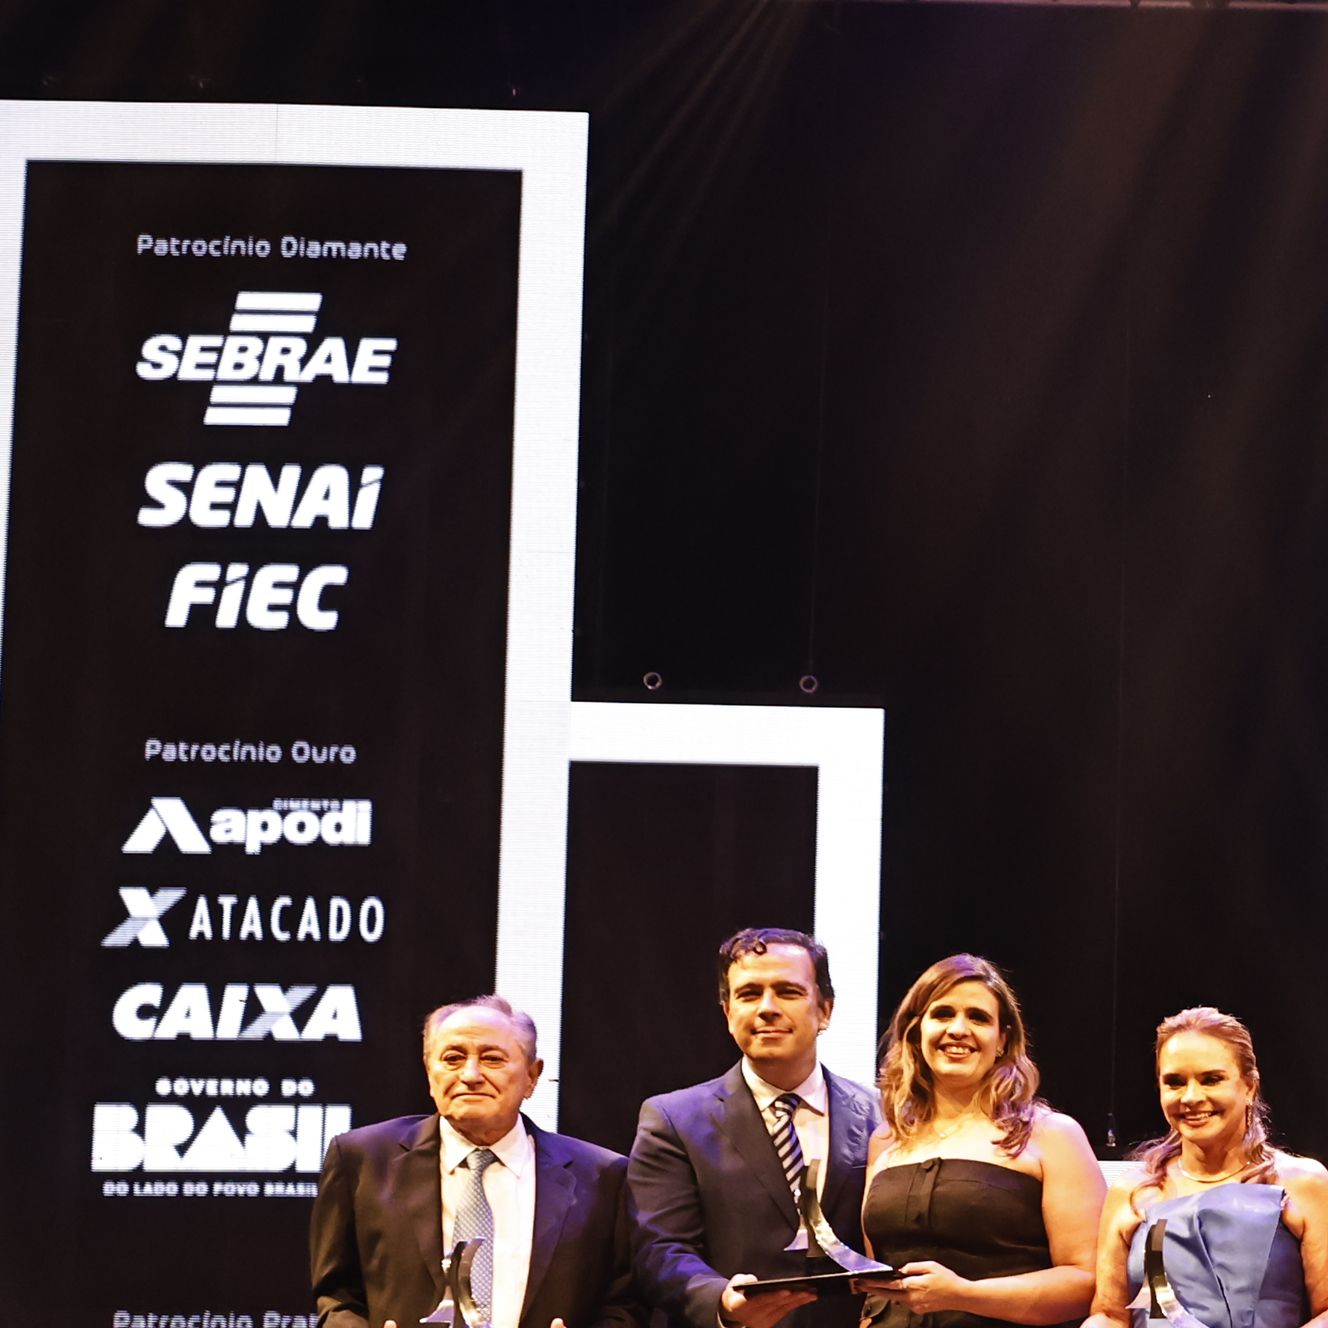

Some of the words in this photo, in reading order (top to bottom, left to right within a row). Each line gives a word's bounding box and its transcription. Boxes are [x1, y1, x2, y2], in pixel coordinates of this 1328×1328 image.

[137, 235, 271, 257] Patrocínio
[281, 236, 407, 260] Diamante
[136, 334, 398, 384] SEBRAE
[145, 738, 282, 763] Patrocínio
[291, 741, 356, 764] Ouro
[189, 894, 384, 942] ATACADO
[112, 982, 362, 1042] CAIXA
[155, 1076, 270, 1097] GOVERNO
[281, 1079, 315, 1098] DO
